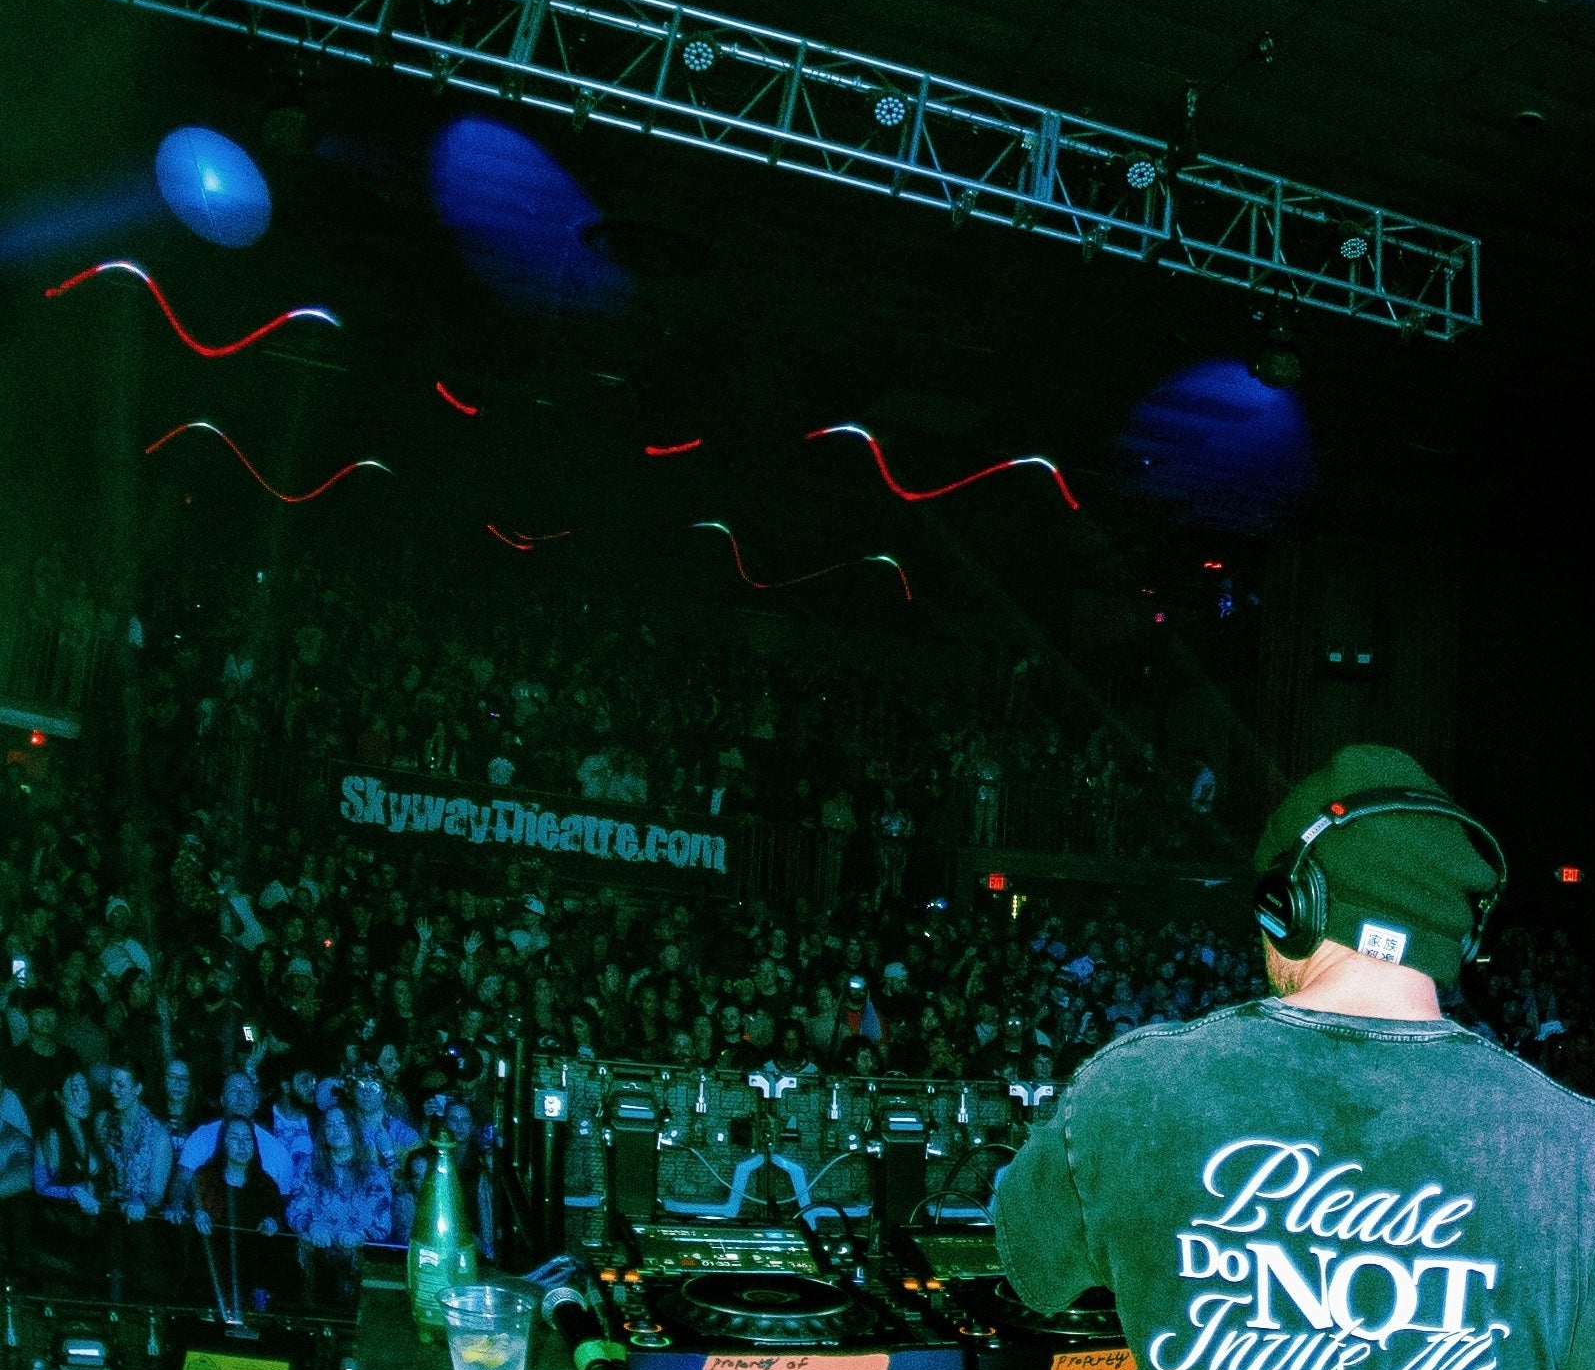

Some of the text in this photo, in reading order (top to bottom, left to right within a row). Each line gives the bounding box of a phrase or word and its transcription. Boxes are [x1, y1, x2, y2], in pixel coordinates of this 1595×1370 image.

[340, 775, 725, 873] SkywayTheatre.com
[1191, 1139, 1474, 1249] Please
[1176, 1233, 1497, 1342] Do NOT
[786, 1357, 809, 1370] of
